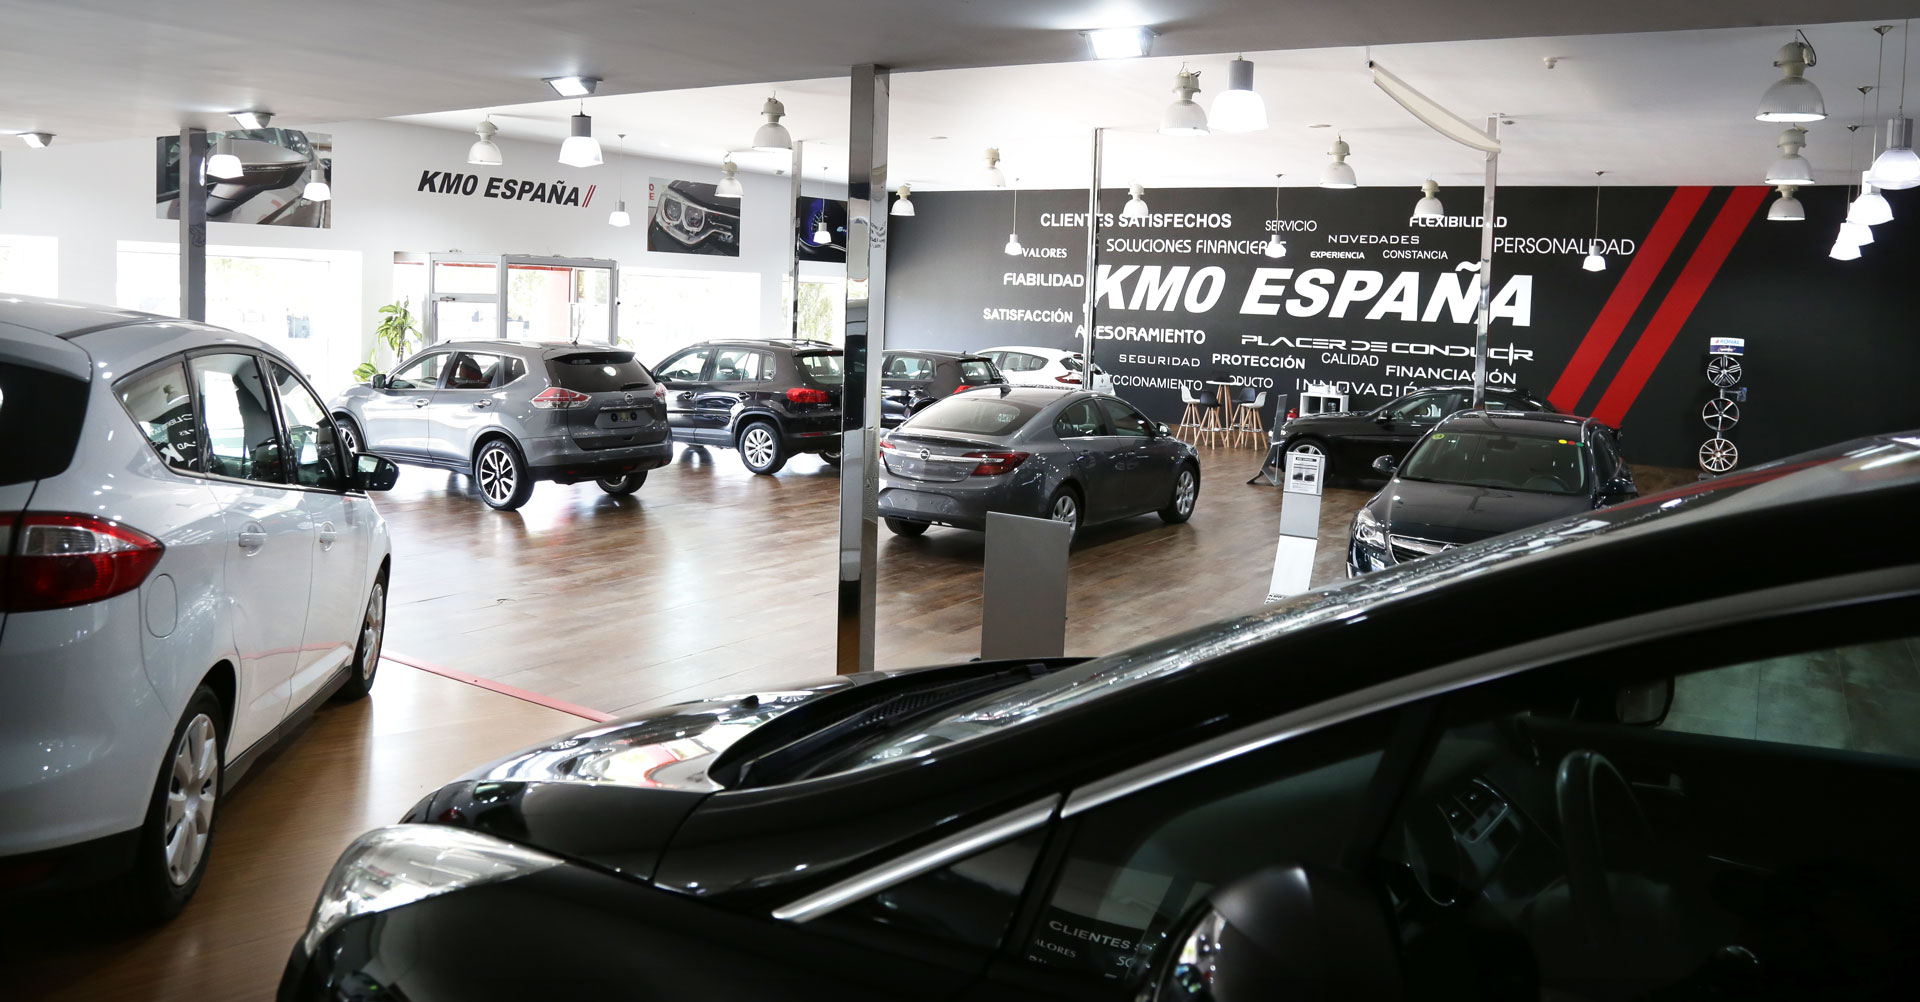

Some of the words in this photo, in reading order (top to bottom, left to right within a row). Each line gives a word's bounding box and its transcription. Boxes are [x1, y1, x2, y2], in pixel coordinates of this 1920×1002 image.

[483, 177, 580, 207] ESPAÑA
[1118, 212, 1232, 229] SATISFECHOS
[1265, 220, 1318, 232] SERVICIO
[1409, 215, 1508, 228] FLEXIBILIDD
[1106, 238, 1192, 254] SOLUCIONES
[1196, 239, 1287, 256] FINANCIER
[1328, 234, 1420, 245] NOVEDADES
[1494, 237, 1635, 255] PERSONALIDAD
[1022, 247, 1068, 258] VALORES
[1310, 251, 1365, 260] EXPERIENCIA
[1382, 249, 1448, 260] CONSTANCIA
[1003, 272, 1084, 288] FIABILIDAD
[1239, 261, 1534, 327] ESPAÑA
[983, 308, 1073, 324] SATISFACCIÓN
[1075, 324, 1206, 345] AESORAMIENTO
[1241, 334, 1347, 351] PLACER
[1351, 340, 1388, 353] DE
[1391, 341, 1534, 367] CONDUCIR
[1119, 353, 1201, 367] SEGURIDAD
[1212, 353, 1306, 370] PROTECCIÓN
[1321, 352, 1379, 367] CALIDAD
[1296, 377, 1425, 399] INOVACIÓ
[1049, 920, 1131, 950] CLIENTES
[1035, 938, 1077, 958] ALORES
